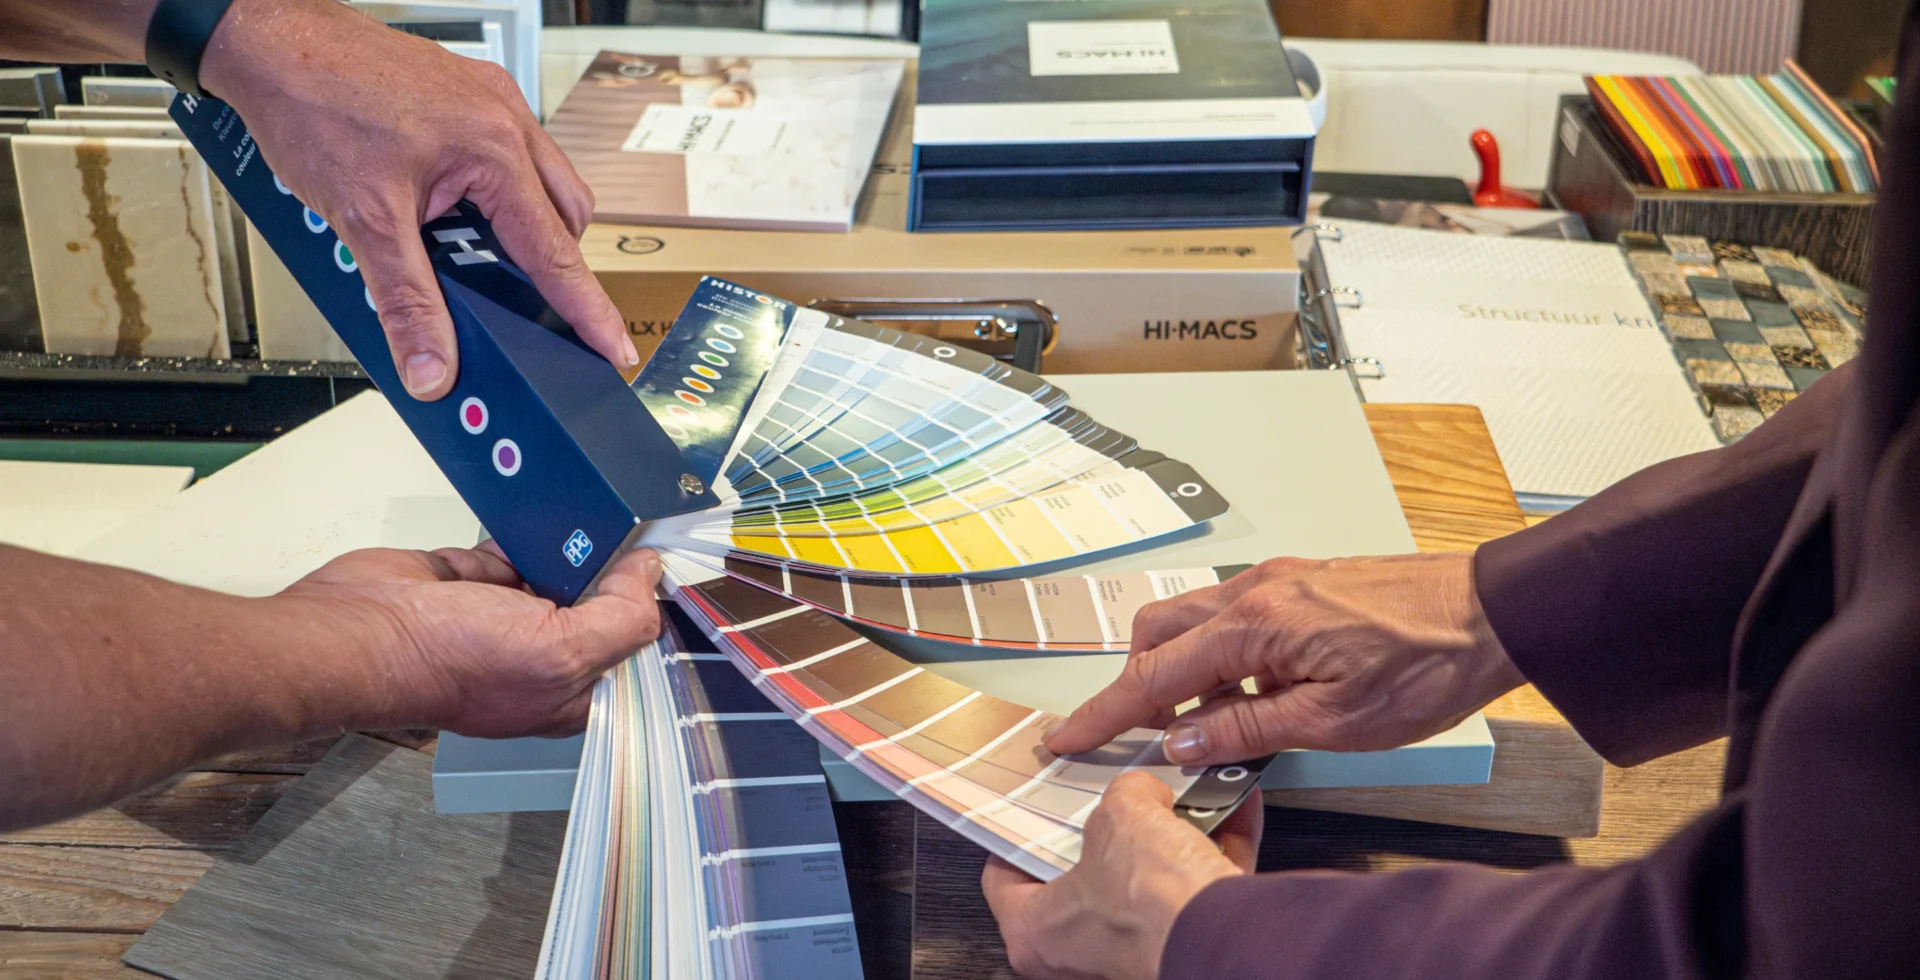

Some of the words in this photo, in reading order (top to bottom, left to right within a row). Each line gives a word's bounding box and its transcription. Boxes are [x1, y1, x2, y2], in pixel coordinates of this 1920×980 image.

[233, 144, 244, 159] La
[236, 142, 257, 177] couleur
[710, 279, 787, 312] HISTOR
[1458, 303, 1601, 326] Structuur
[630, 321, 657, 337] LX
[566, 534, 590, 563] PPG
